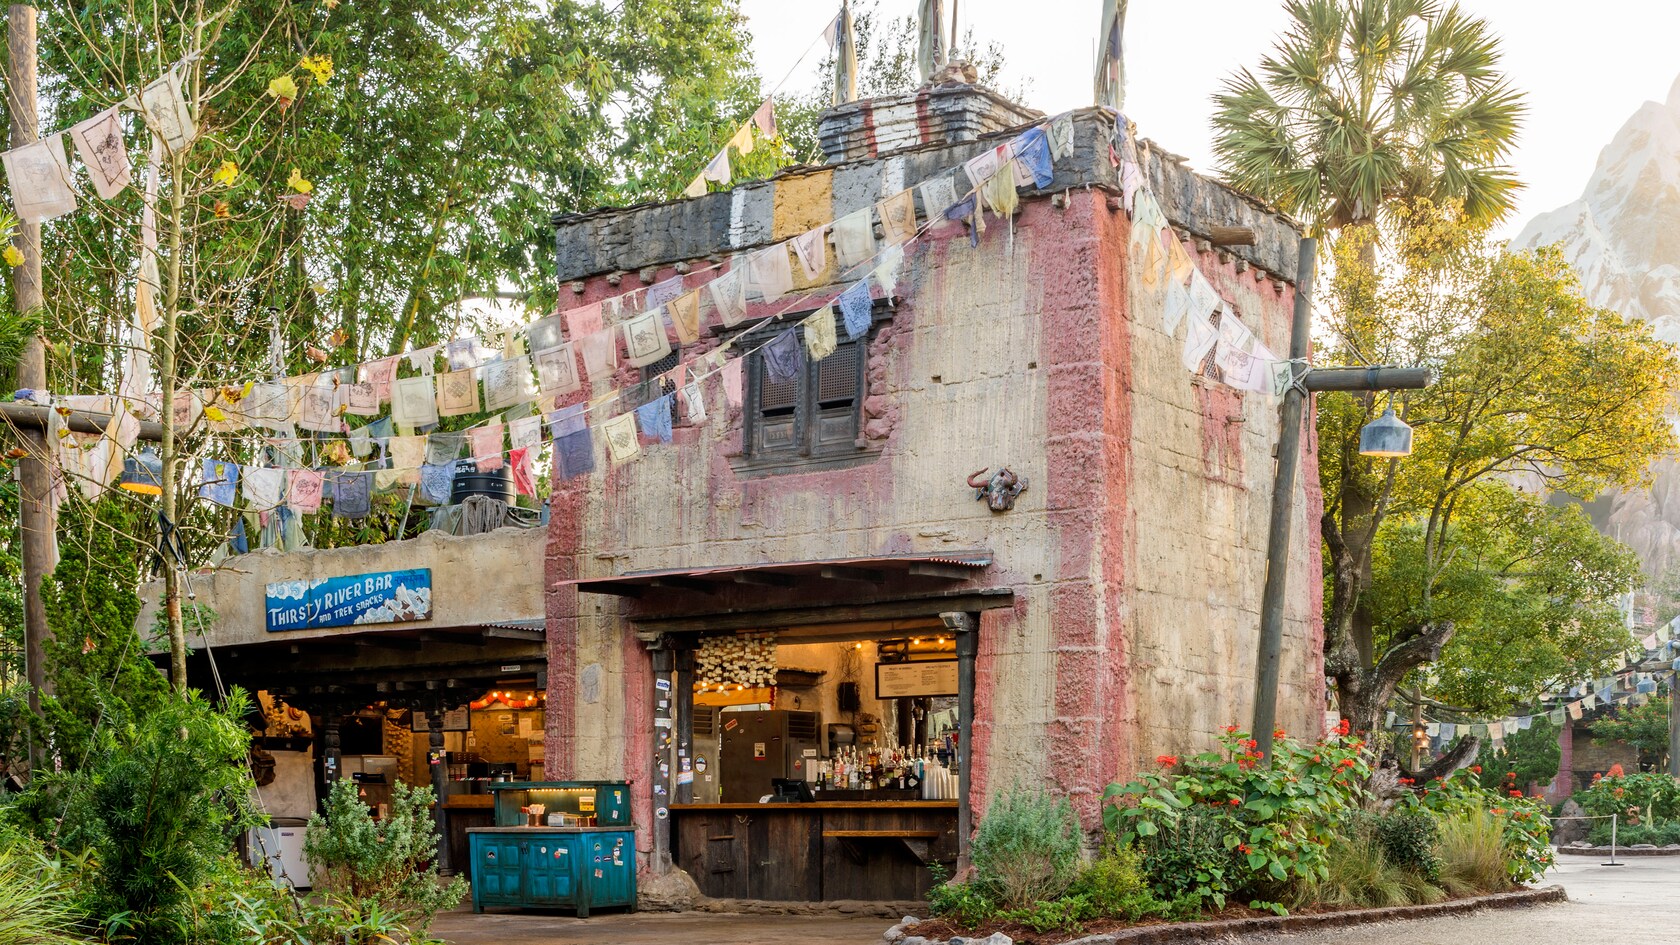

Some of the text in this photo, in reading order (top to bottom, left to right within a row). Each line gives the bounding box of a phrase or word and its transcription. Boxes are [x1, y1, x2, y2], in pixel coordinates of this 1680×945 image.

[267, 573, 393, 627] THIRSTY RIVER BAR
[319, 593, 384, 624] AND TREK SNACKS
